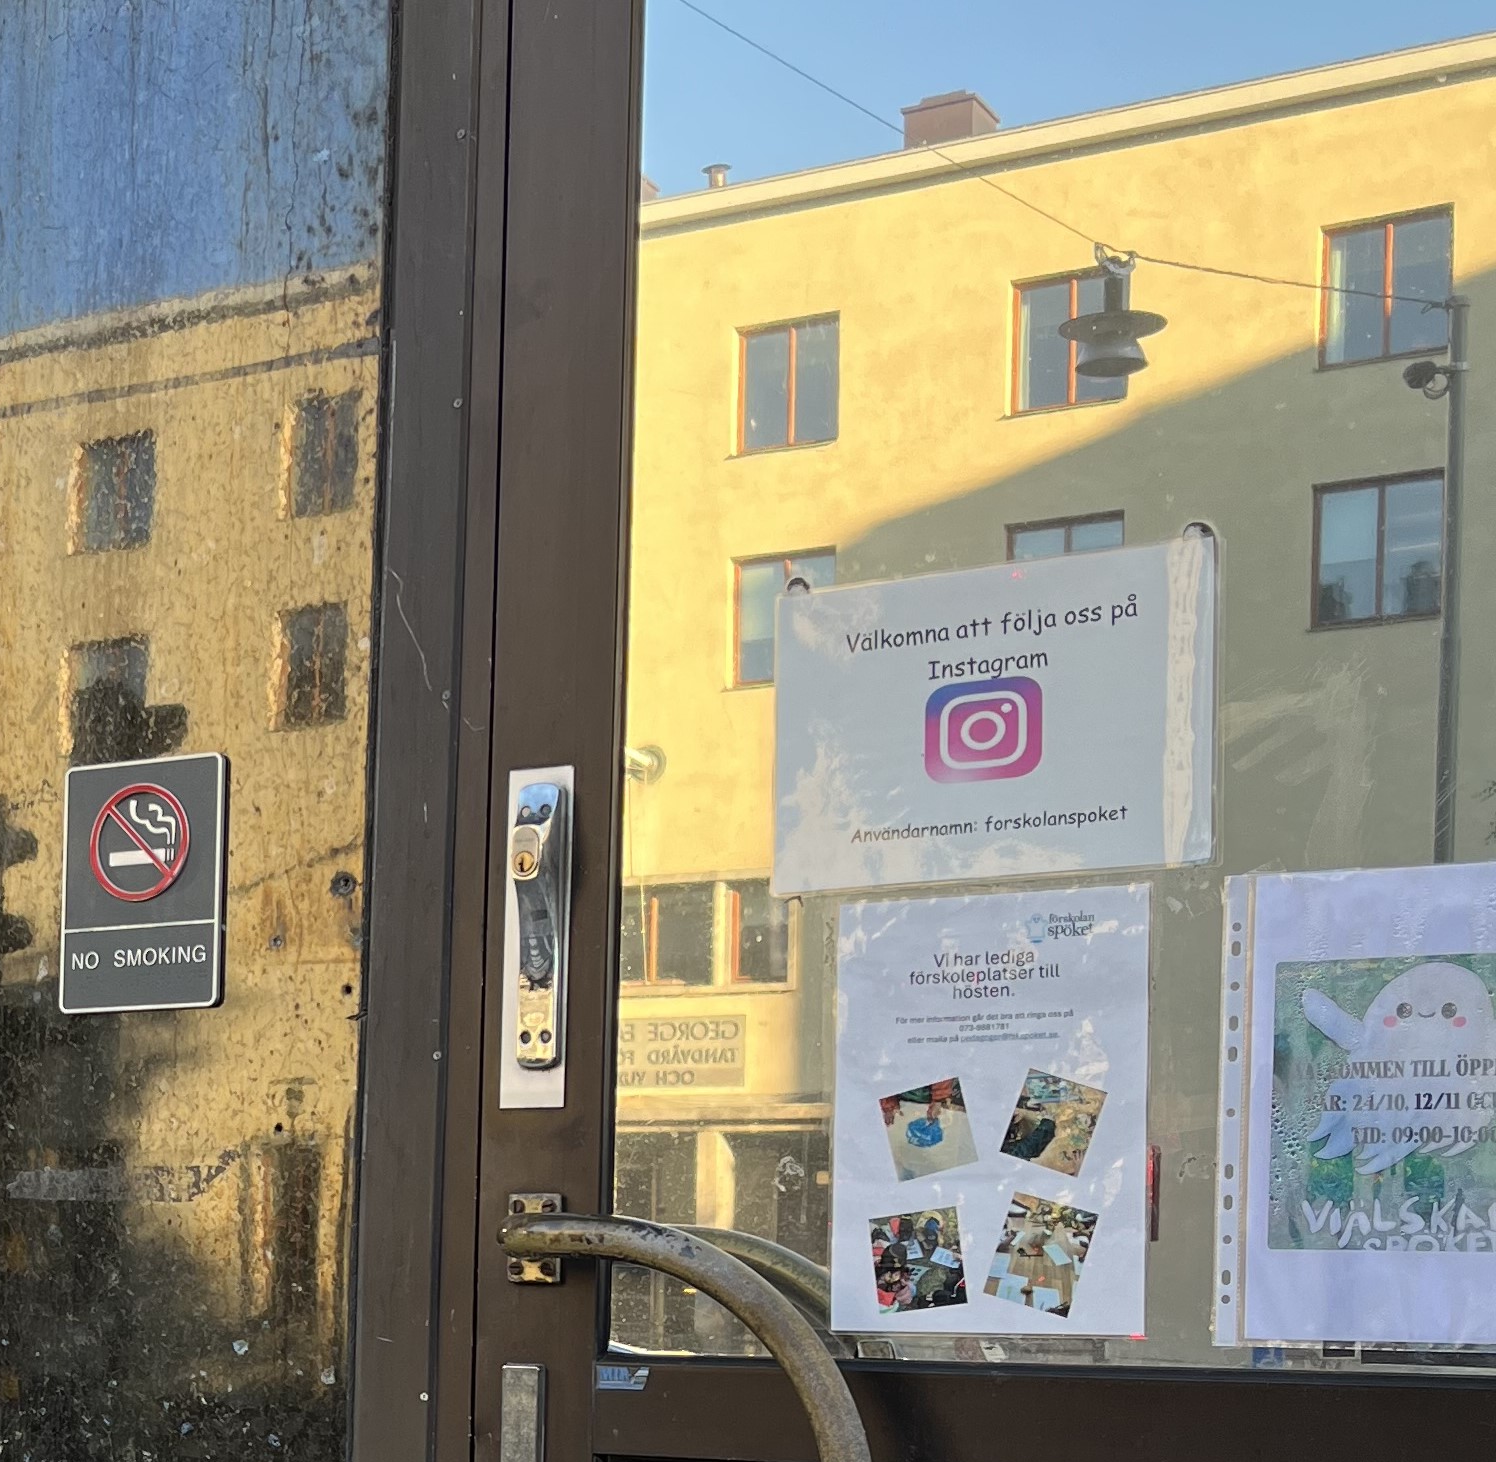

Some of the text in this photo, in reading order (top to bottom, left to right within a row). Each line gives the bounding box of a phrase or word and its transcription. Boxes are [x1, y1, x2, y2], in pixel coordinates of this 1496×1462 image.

[846, 593, 1138, 654] Välkomna att följa oss på
[927, 650, 1049, 680] Instagram
[850, 805, 1129, 844] Användarnamn: forskolanspoket
[1048, 910, 1095, 924] förskolan
[1047, 921, 1094, 939] spöket
[71, 944, 207, 971] NO SMOKING
[933, 949, 1036, 968] Vi har lediga
[909, 963, 1061, 987] förskoleplatser till
[952, 984, 1016, 1000] hösten.
[1410, 1058, 1451, 1078] TILL
[1414, 1092, 1460, 1110] 12/11
[1466, 1091, 1496, 1110] OC
[1351, 1126, 1387, 1144] TID:
[1337, 1195, 1496, 1249] ÄLSKA
